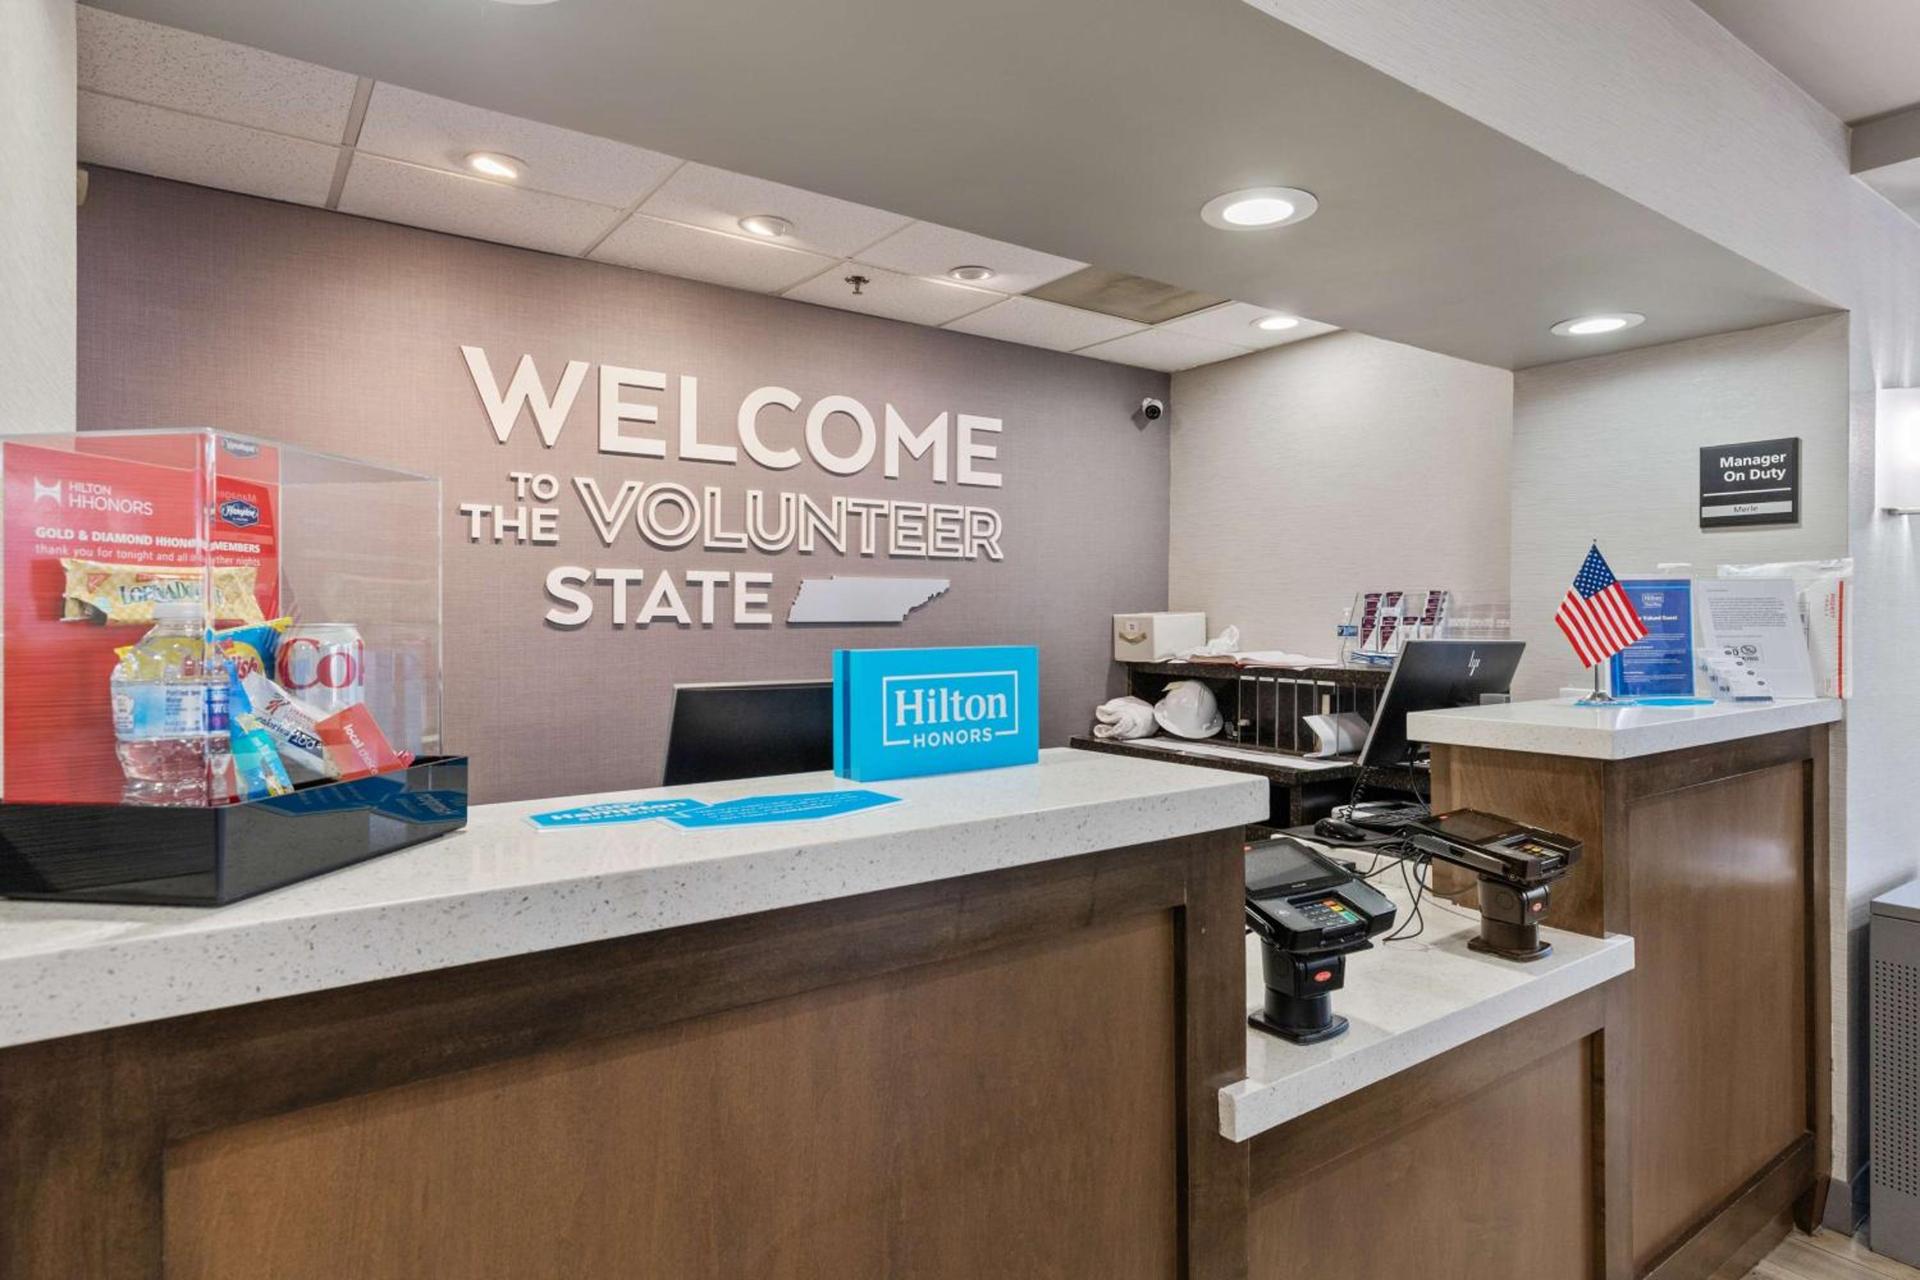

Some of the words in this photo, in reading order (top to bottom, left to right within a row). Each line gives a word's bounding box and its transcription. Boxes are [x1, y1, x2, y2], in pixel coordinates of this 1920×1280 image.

[460, 345, 1003, 487] WELCOME
[1719, 453, 1787, 469] Manager
[1723, 470, 1746, 483] On
[1749, 467, 1787, 481] Duty
[69, 481, 112, 495] HILTON
[509, 471, 559, 501] TO
[68, 494, 153, 516] HHONORS
[573, 476, 1003, 560] VOLUNTEER
[459, 502, 560, 544] THE
[35, 526, 74, 540] GOLD
[78, 529, 88, 541] &
[92, 531, 153, 546] DIAMOND
[214, 540, 261, 554] MEMBERS
[35, 544, 68, 556] thank
[72, 547, 93, 559] you
[97, 547, 113, 558] for
[116, 548, 154, 563] tonight
[156, 551, 174, 562] and
[177, 552, 188, 563] all
[543, 566, 773, 627] STATE
[1468, 649, 1481, 677] hp
[894, 687, 1009, 727] Hilton
[343, 724, 366, 749] local
[912, 727, 993, 749] HONORS
